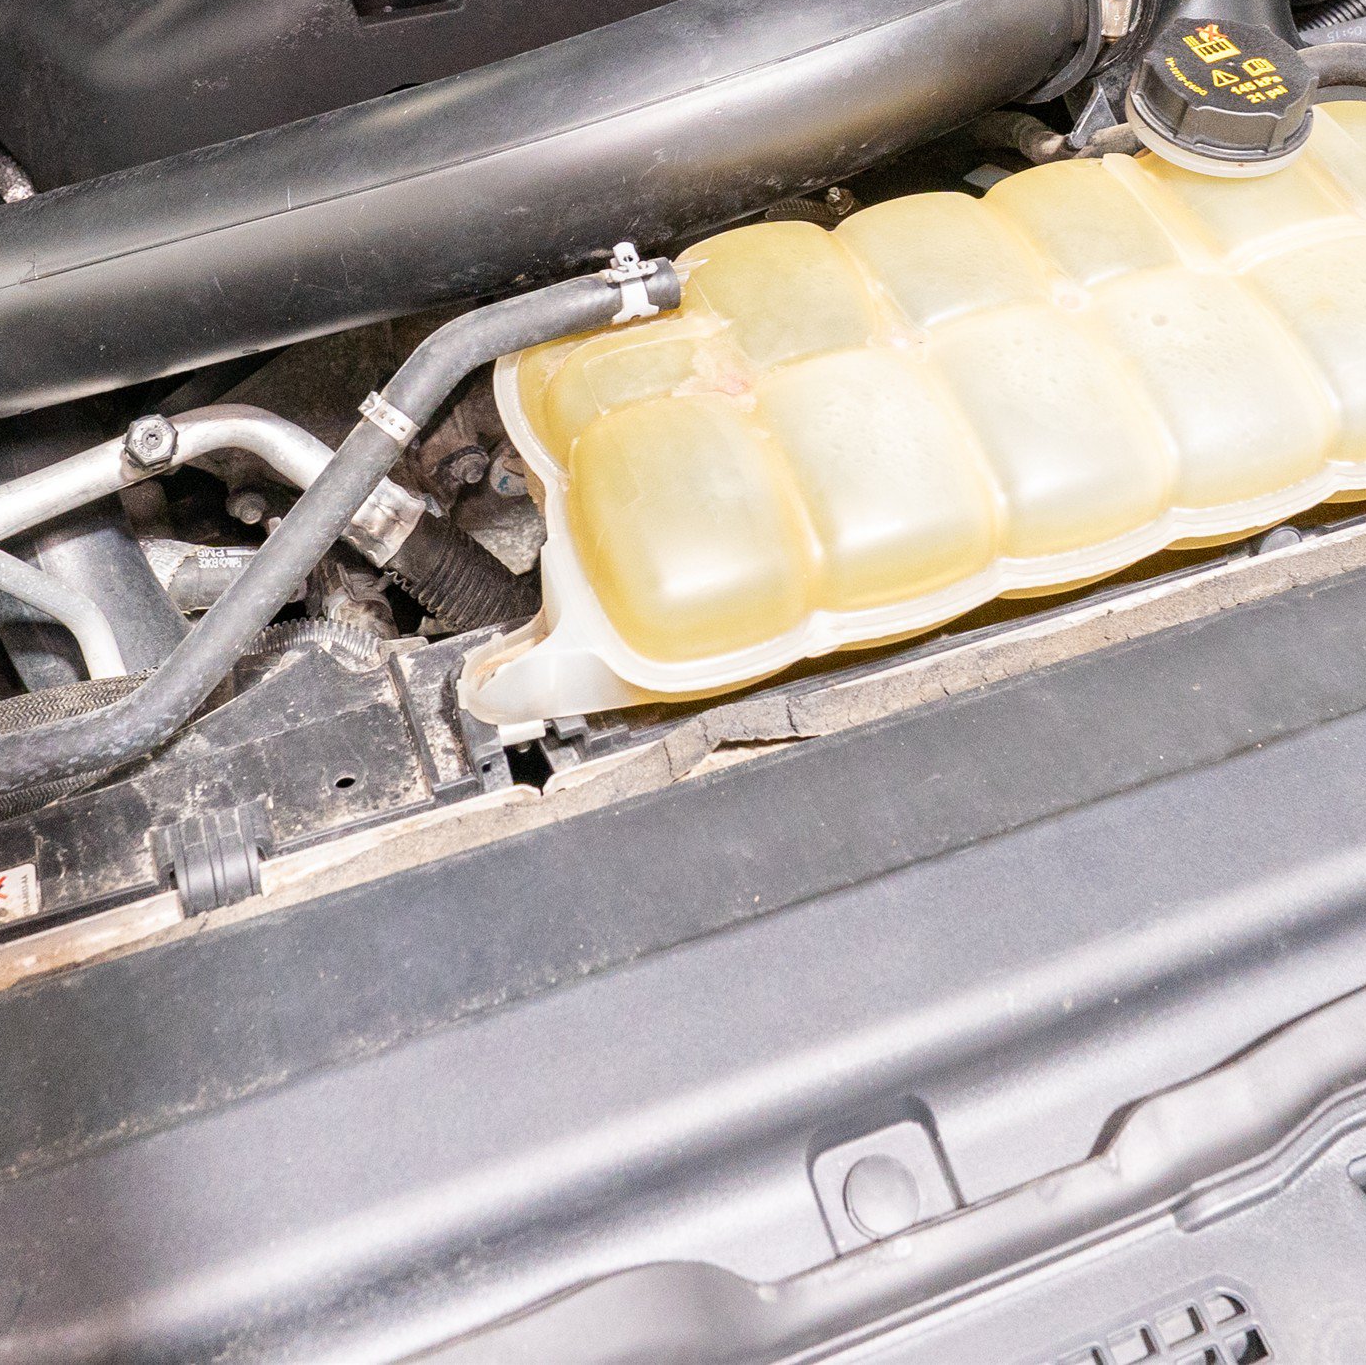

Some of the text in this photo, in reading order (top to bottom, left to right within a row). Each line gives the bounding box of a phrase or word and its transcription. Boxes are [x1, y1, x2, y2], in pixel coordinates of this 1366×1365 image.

[1230, 81, 1257, 95] 145
[1246, 84, 1289, 104] 21 psi
